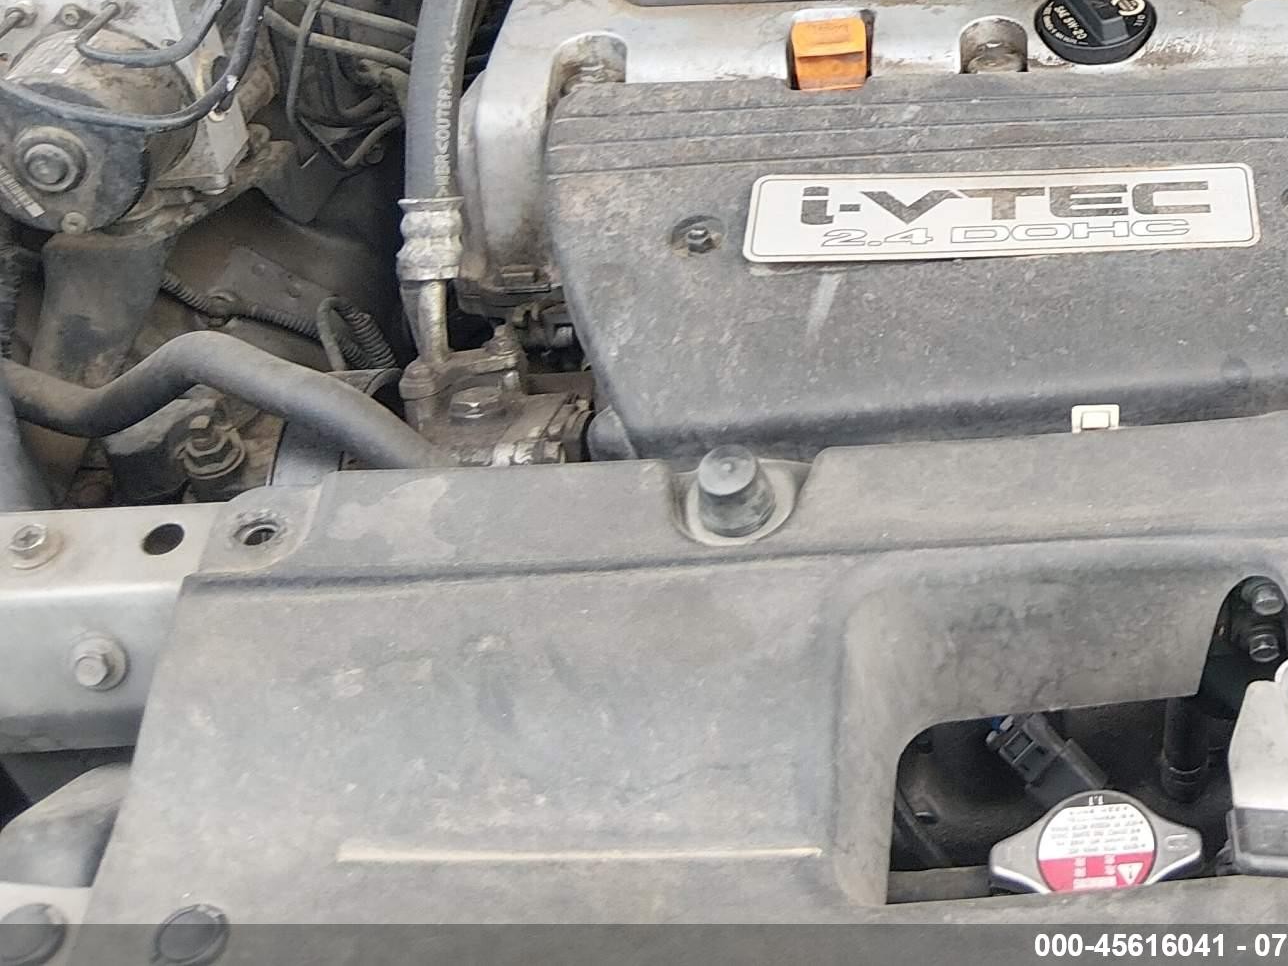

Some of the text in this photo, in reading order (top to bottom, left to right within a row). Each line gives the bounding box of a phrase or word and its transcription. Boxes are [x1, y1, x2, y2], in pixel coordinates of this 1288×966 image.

[800, 180, 1212, 227] i-VTEC
[820, 218, 1192, 249] 2.4 DOHC
